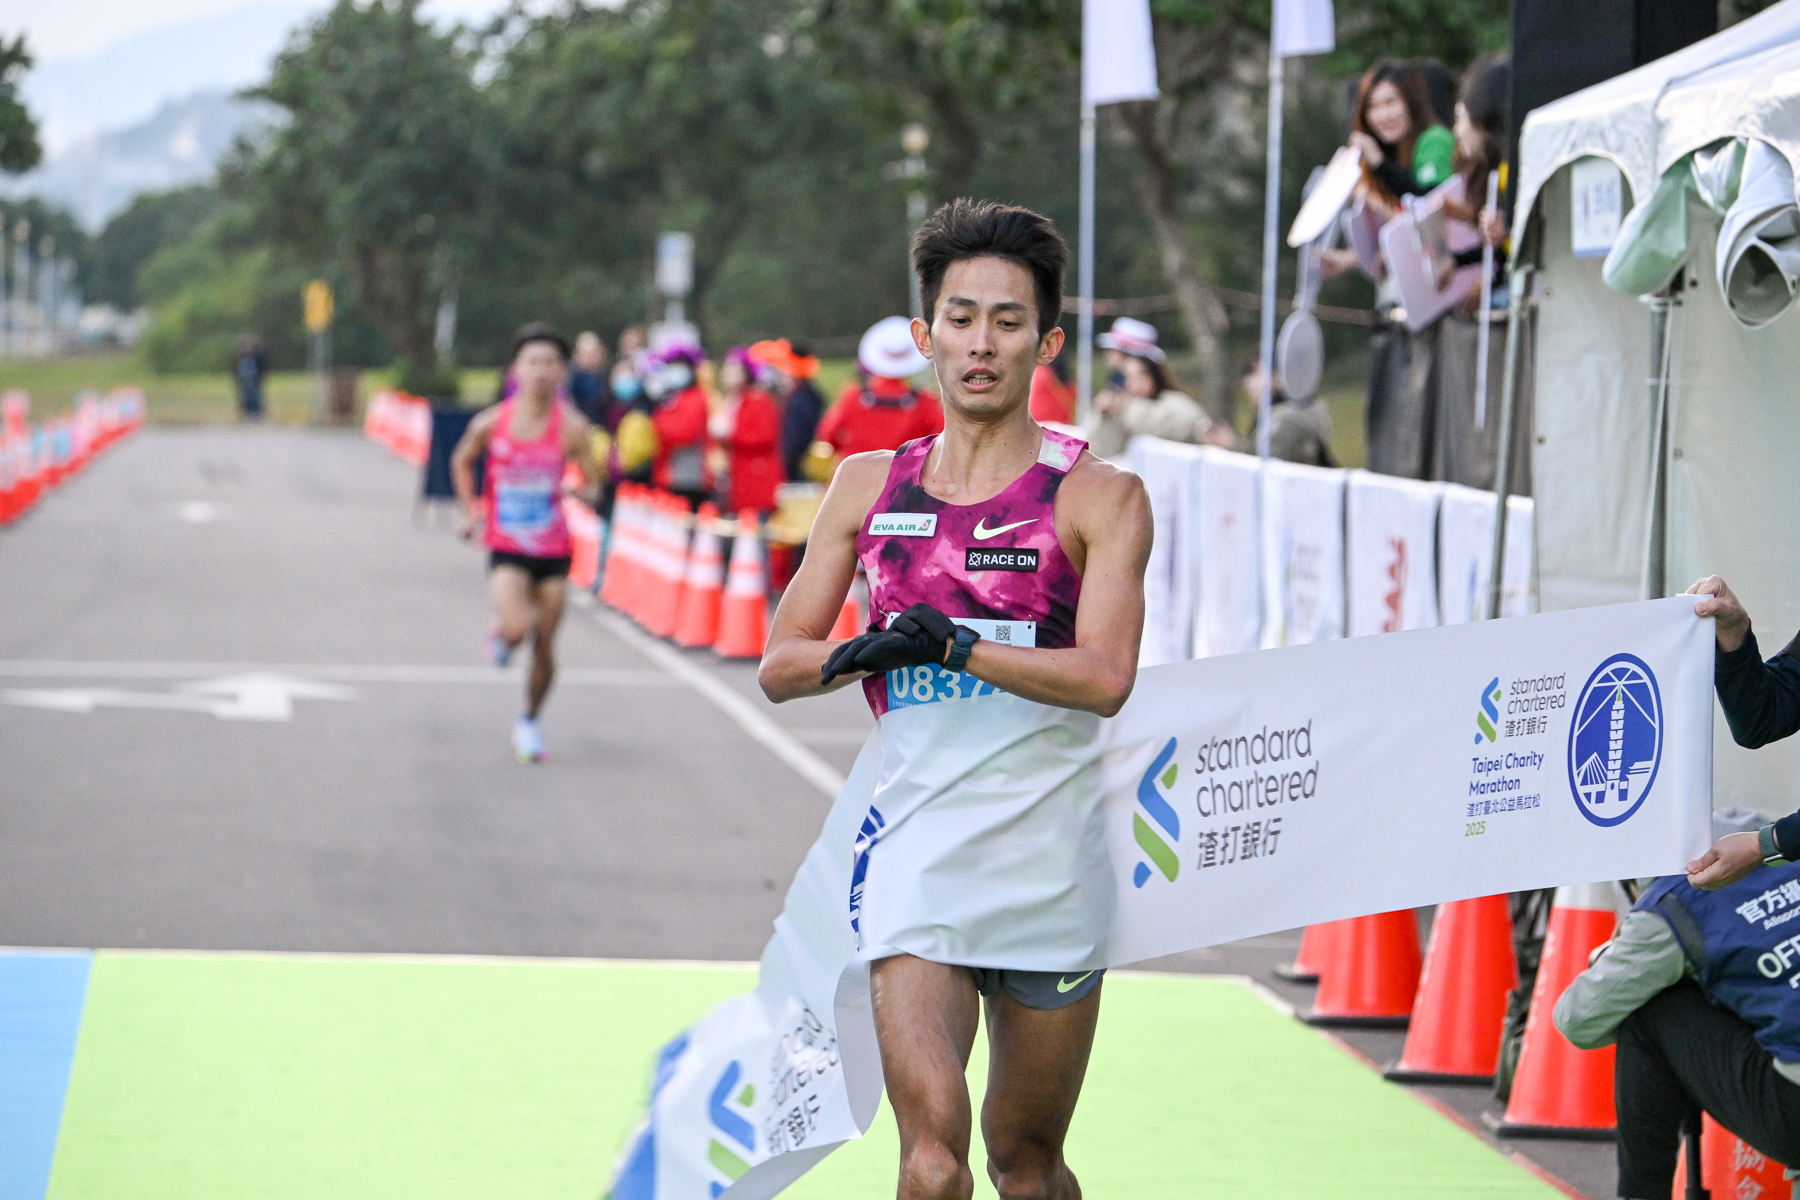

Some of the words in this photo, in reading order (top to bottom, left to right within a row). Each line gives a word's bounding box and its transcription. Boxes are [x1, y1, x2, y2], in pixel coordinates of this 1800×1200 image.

[983, 554, 1014, 565] RACE
[1017, 555, 1036, 566] ON
[1509, 672, 1566, 696] standard
[1507, 691, 1566, 715] chartered
[1504, 715, 1548, 738] 渣打銀行
[1195, 718, 1312, 775] standard
[1471, 755, 1503, 777] Taipei
[1505, 751, 1545, 771] Charity
[1196, 760, 1319, 817] chartered
[1468, 776, 1521, 796] Marathon
[1466, 794, 1541, 818] 渣打臺北公益馬拉松
[1464, 821, 1486, 838] 2025
[1196, 817, 1282, 870] 渣打銀行
